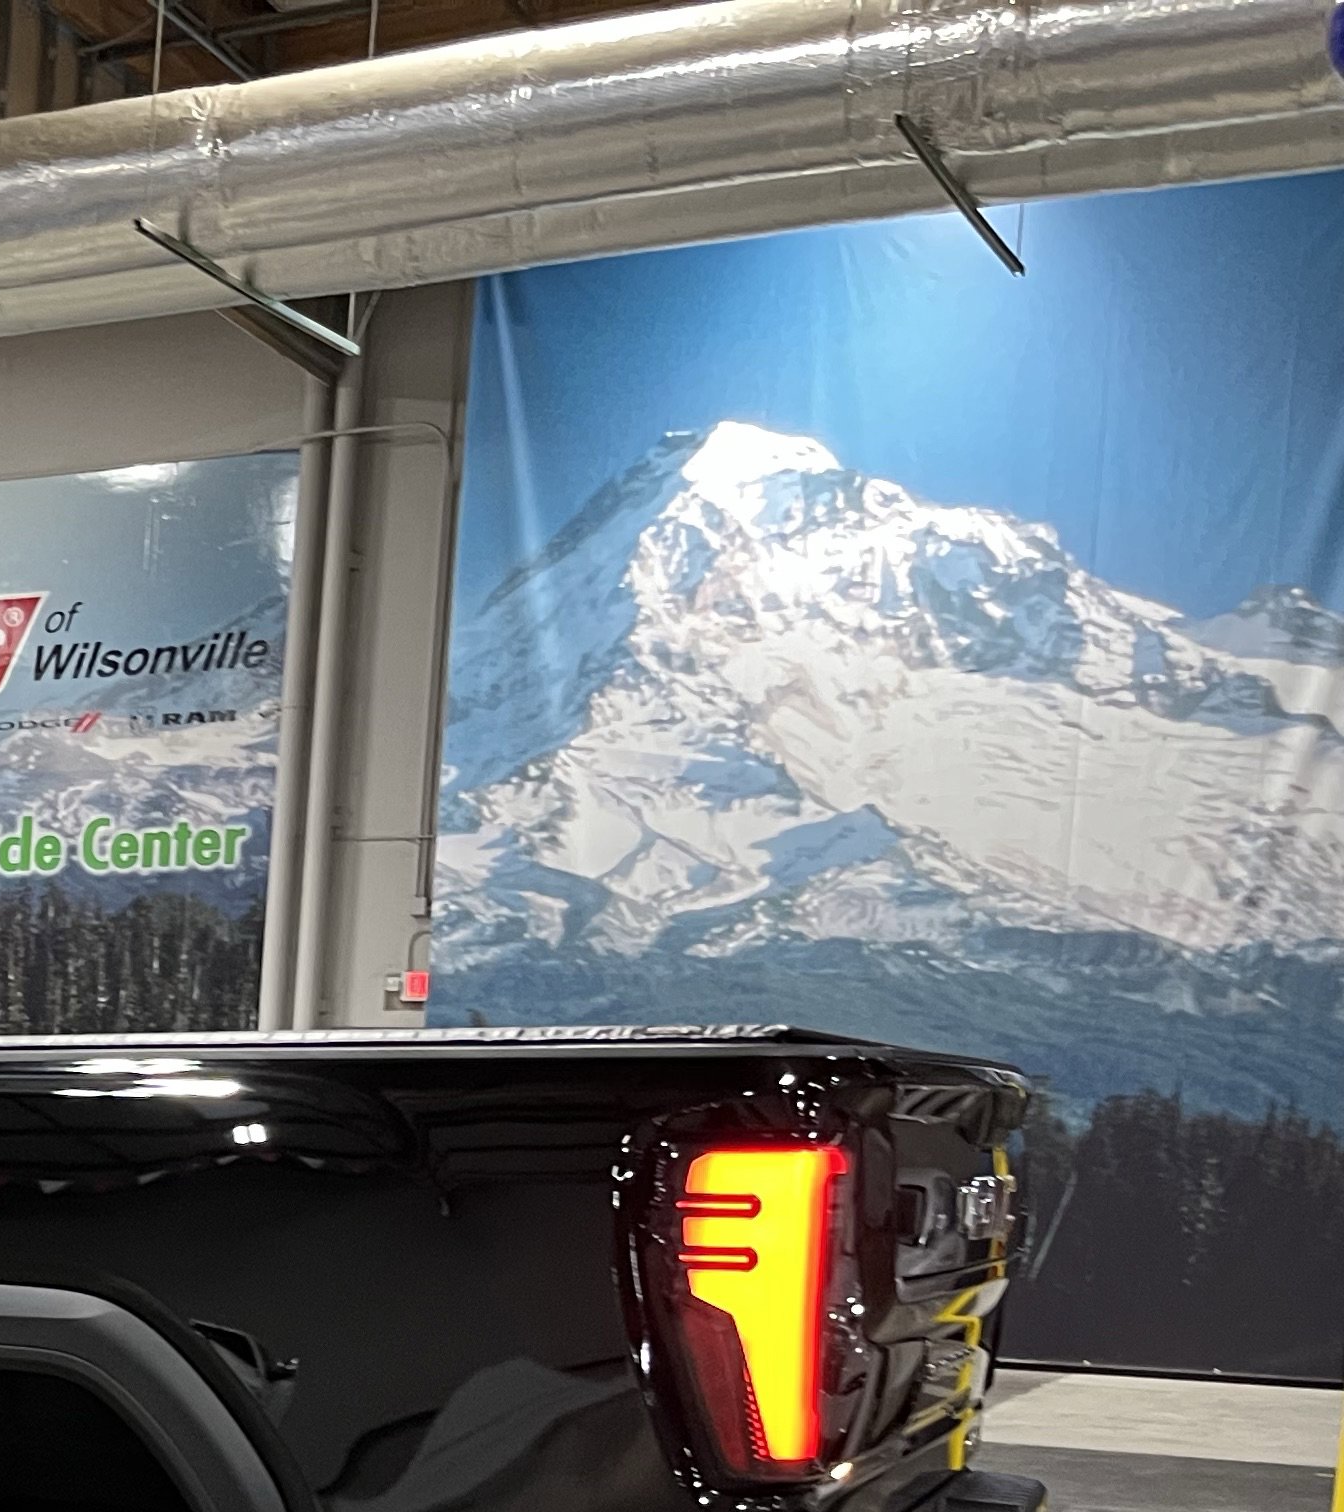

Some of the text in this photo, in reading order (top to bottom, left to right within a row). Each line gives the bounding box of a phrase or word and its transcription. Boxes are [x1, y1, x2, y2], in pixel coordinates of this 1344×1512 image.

[45, 602, 83, 634] of
[32, 630, 270, 683] Wilsonville
[161, 708, 238, 727] RAM
[81, 816, 248, 872] Center
